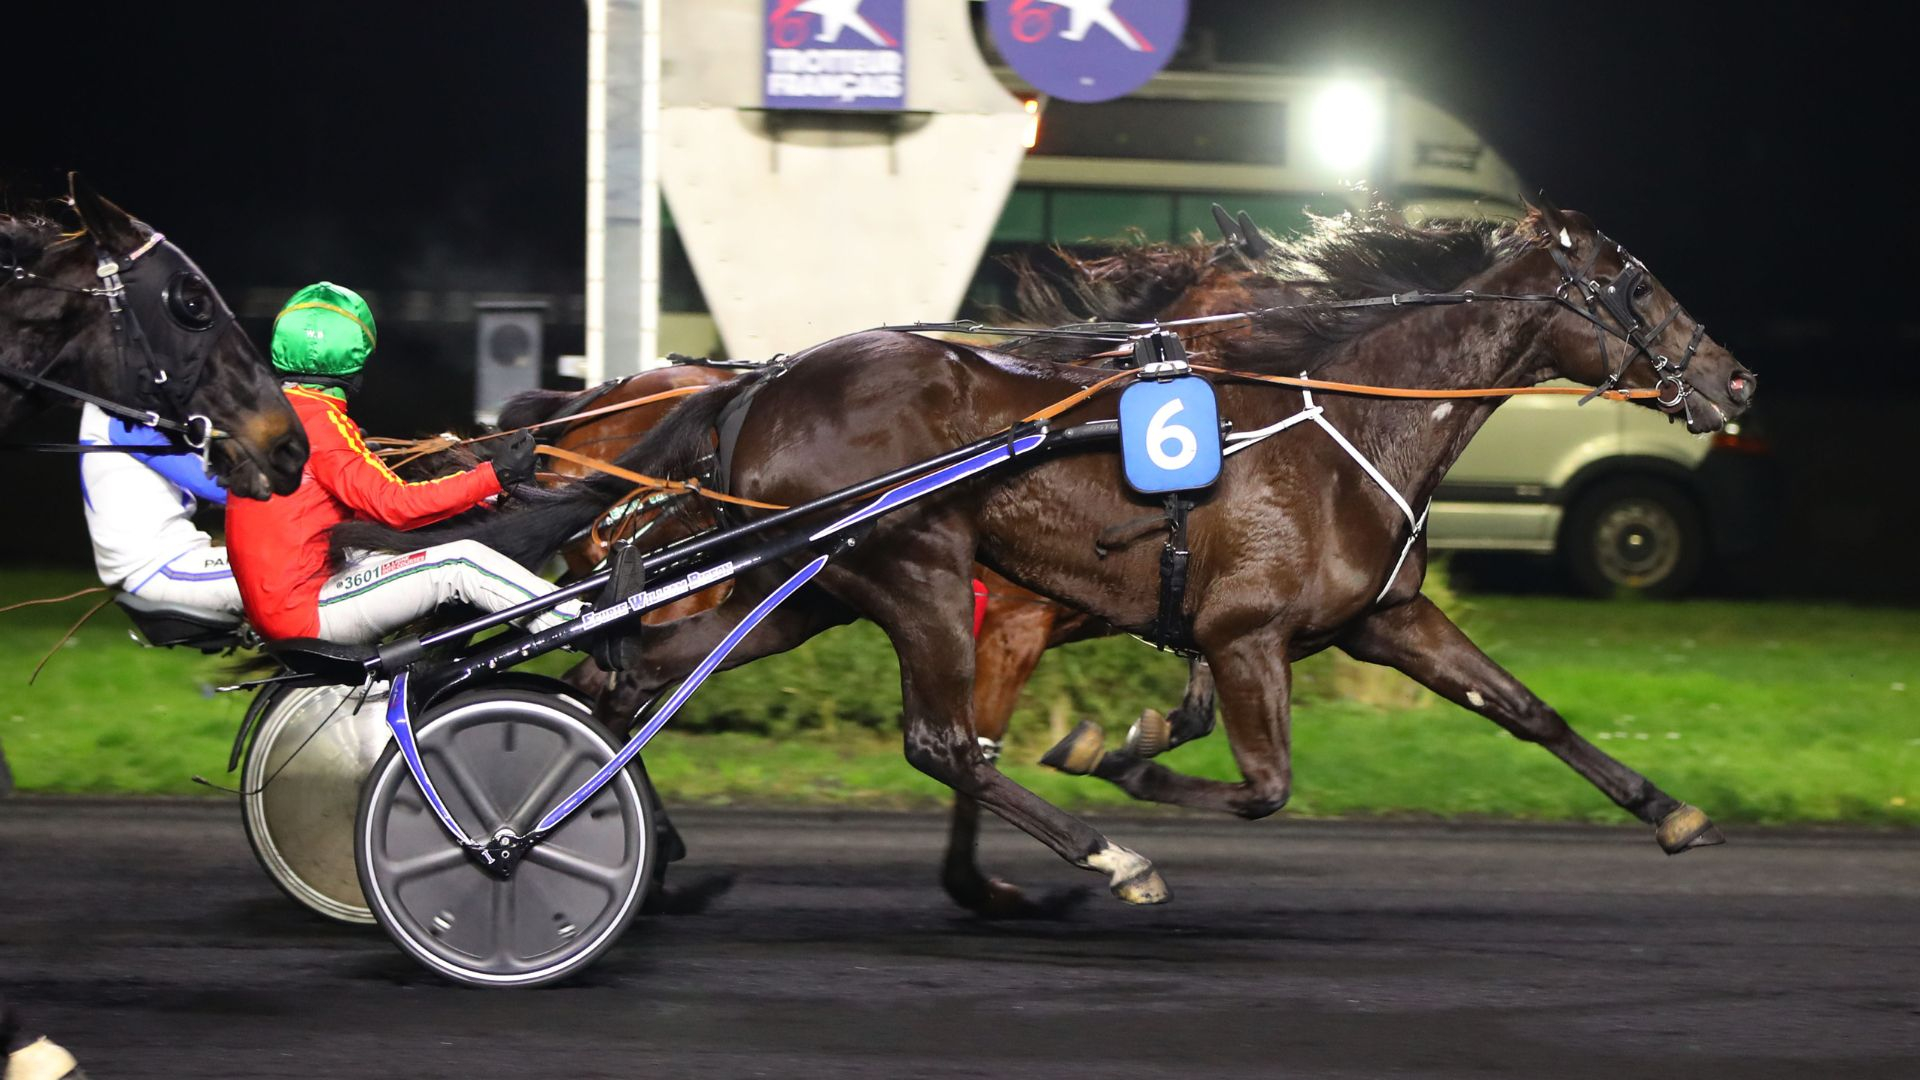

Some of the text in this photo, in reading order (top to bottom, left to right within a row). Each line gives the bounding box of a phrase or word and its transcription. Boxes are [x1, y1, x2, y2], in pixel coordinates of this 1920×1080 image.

[768, 49, 902, 73] TROTTEUR
[767, 73, 902, 102] FRANÇAIS
[1146, 397, 1198, 471] 6
[204, 558, 229, 568] PA
[345, 566, 380, 590] 3601
